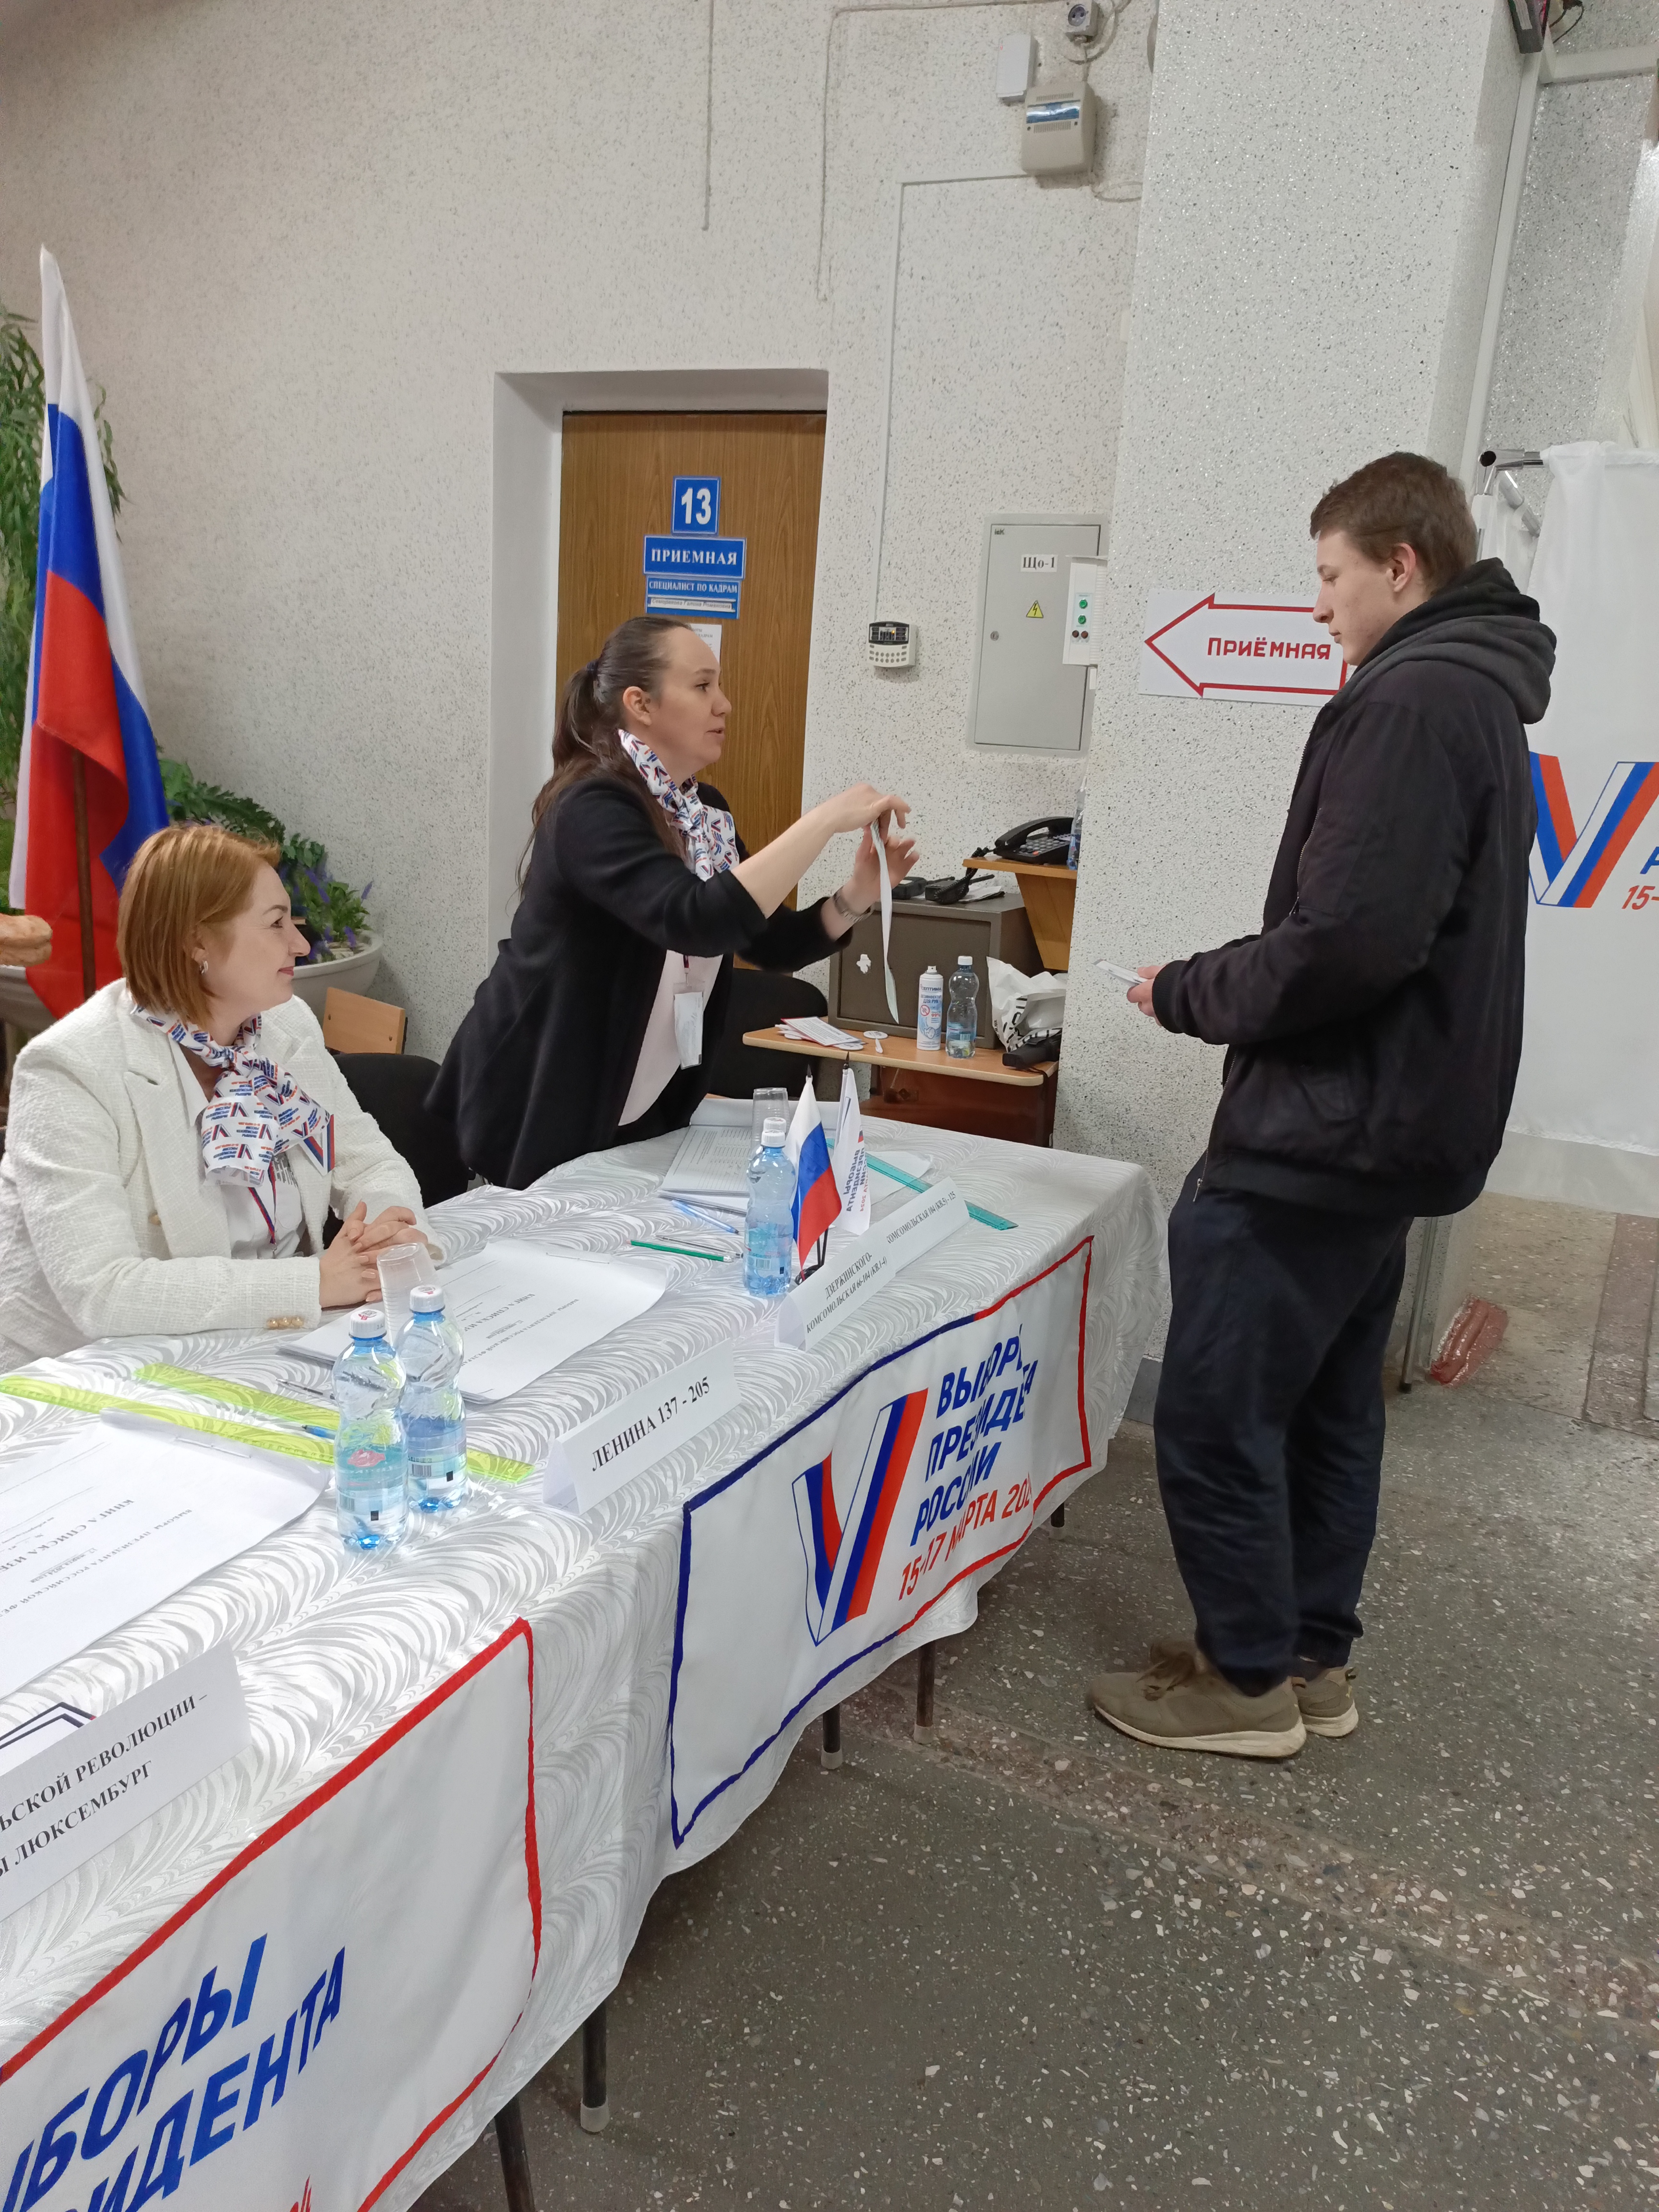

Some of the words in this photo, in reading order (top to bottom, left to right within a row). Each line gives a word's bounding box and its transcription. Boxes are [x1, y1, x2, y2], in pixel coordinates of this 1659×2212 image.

[681, 487, 711, 525] 13
[651, 548, 737, 565] ПРИЕМНАЯ
[649, 581, 695, 591] СПЕЦИАЛИСТ
[709, 584, 738, 593] КАДРАМ
[1207, 637, 1331, 660] ПРИЁМНАЯ
[806, 1283, 856, 1334] КОМСОМОЛЬСКАЯ
[592, 1415, 657, 1471] ЛЕНИНА
[658, 1396, 678, 1424] 137
[688, 1376, 710, 1404] 205
[87, 1499, 134, 1523] КНИГА
[910, 1442, 1002, 1547] РОССИ
[154, 1509, 192, 1529] ВЫБОРЫ
[944, 1489, 998, 1562] МРТА
[27, 1525, 87, 1555] СПИСКА
[89, 1530, 152, 1566] ПРЕЗИДЕНТА
[20, 1566, 90, 1604] РОССИЙСКОЙ
[75, 1695, 197, 1784] РЕВОЛЮЦИИ
[15, 1760, 152, 1865] ЛЮКСЕМБУРГ
[65, 1945, 346, 2212] ИДЕНТА
